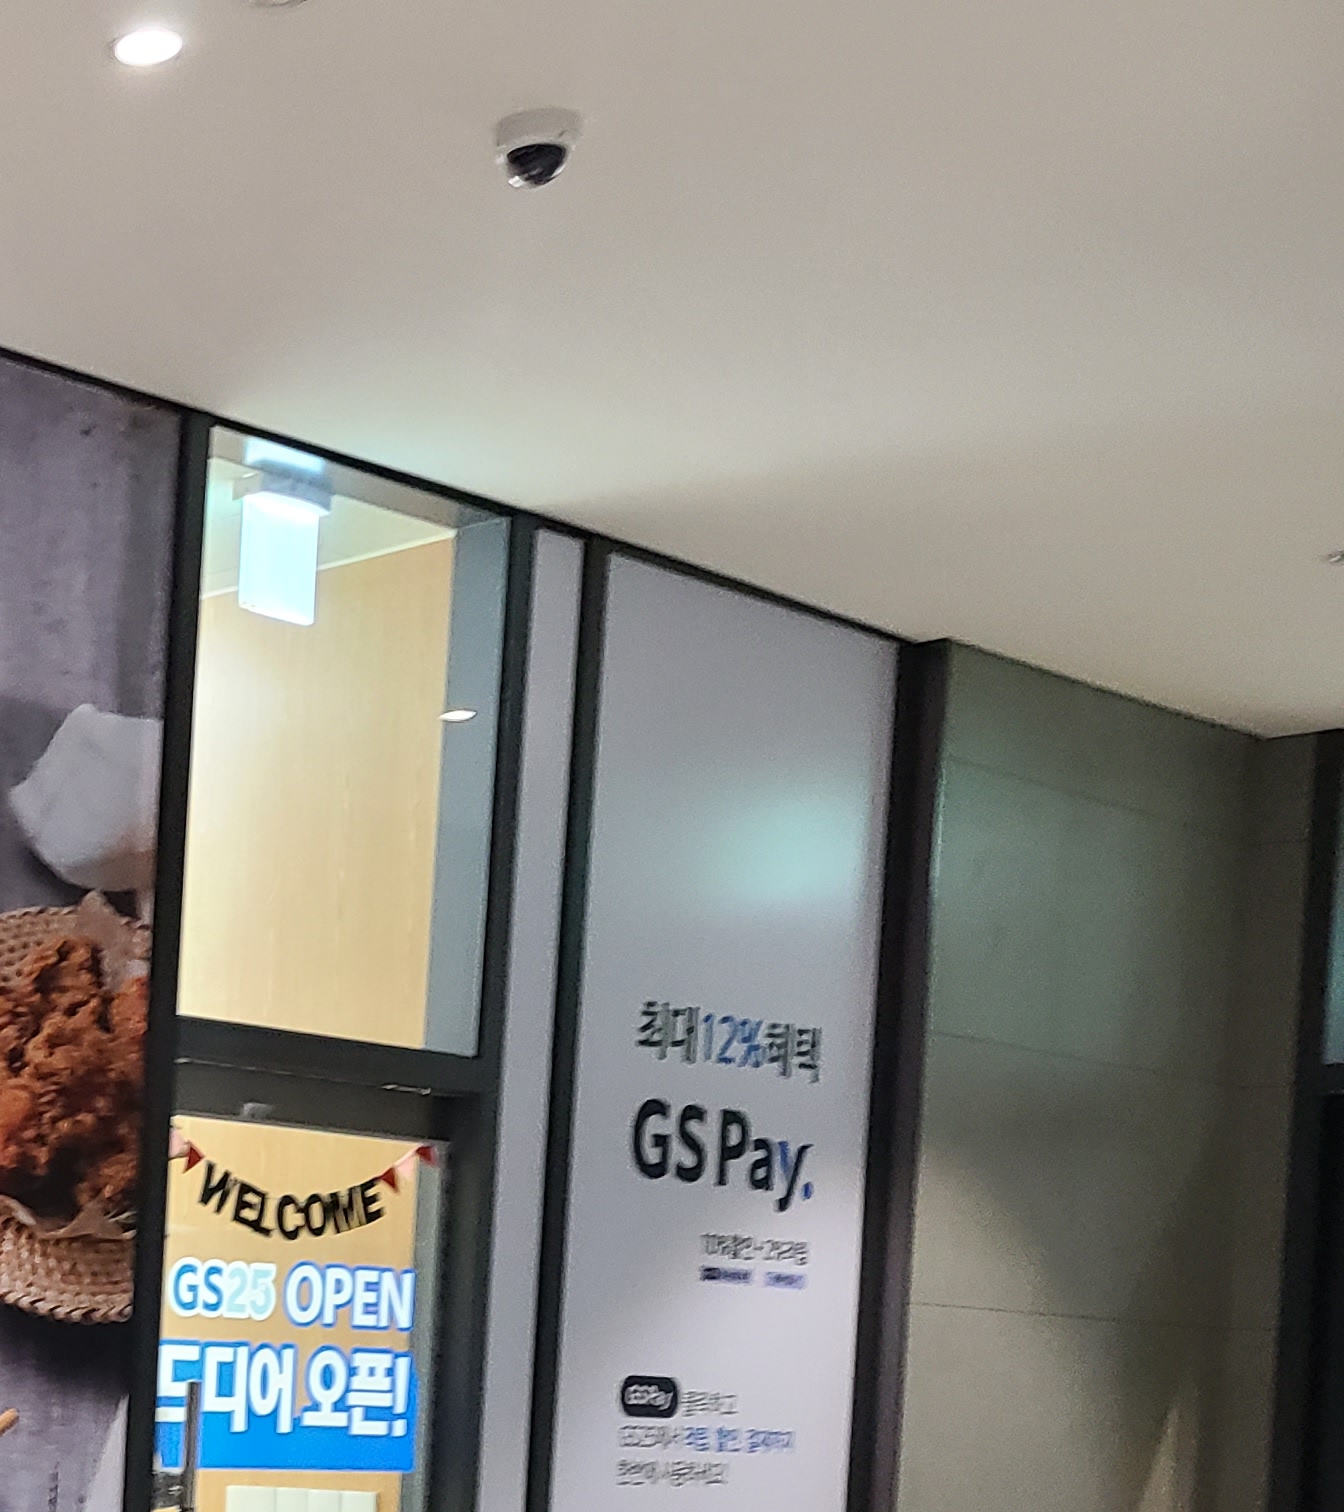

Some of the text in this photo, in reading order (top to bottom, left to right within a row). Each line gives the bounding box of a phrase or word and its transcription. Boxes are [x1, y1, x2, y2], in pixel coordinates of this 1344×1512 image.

[198, 1160, 386, 1240] WELCOME
[170, 1258, 416, 1332] GS25 OPEN
[155, 1342, 412, 1438] 드디어 오픈!
